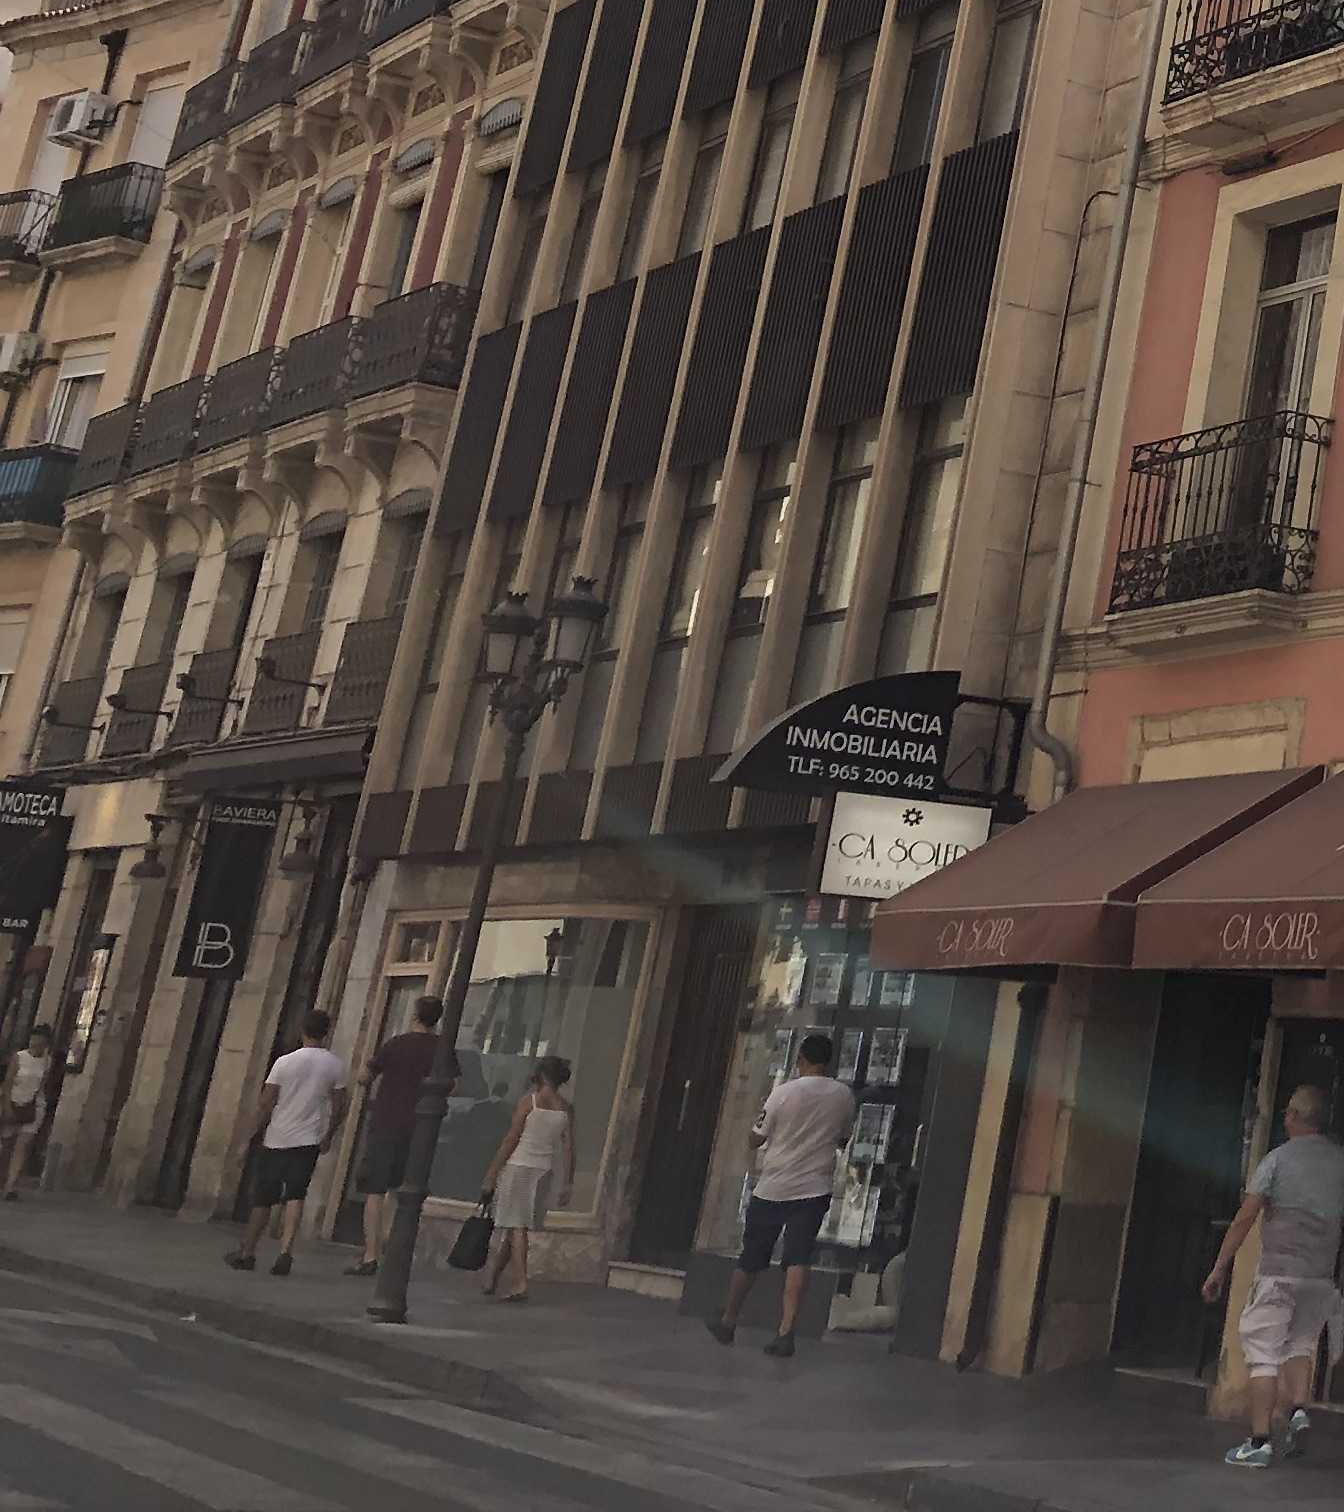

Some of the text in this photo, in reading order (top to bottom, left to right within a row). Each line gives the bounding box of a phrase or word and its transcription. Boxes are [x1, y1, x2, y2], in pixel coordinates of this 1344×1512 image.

[842, 703, 943, 736] AGENCIA
[786, 725, 938, 765] INMOBILIARIA
[788, 755, 935, 791] TLF: 965 200 442
[845, 875, 892, 890] TAPAS
[1, 918, 29, 928] BAR
